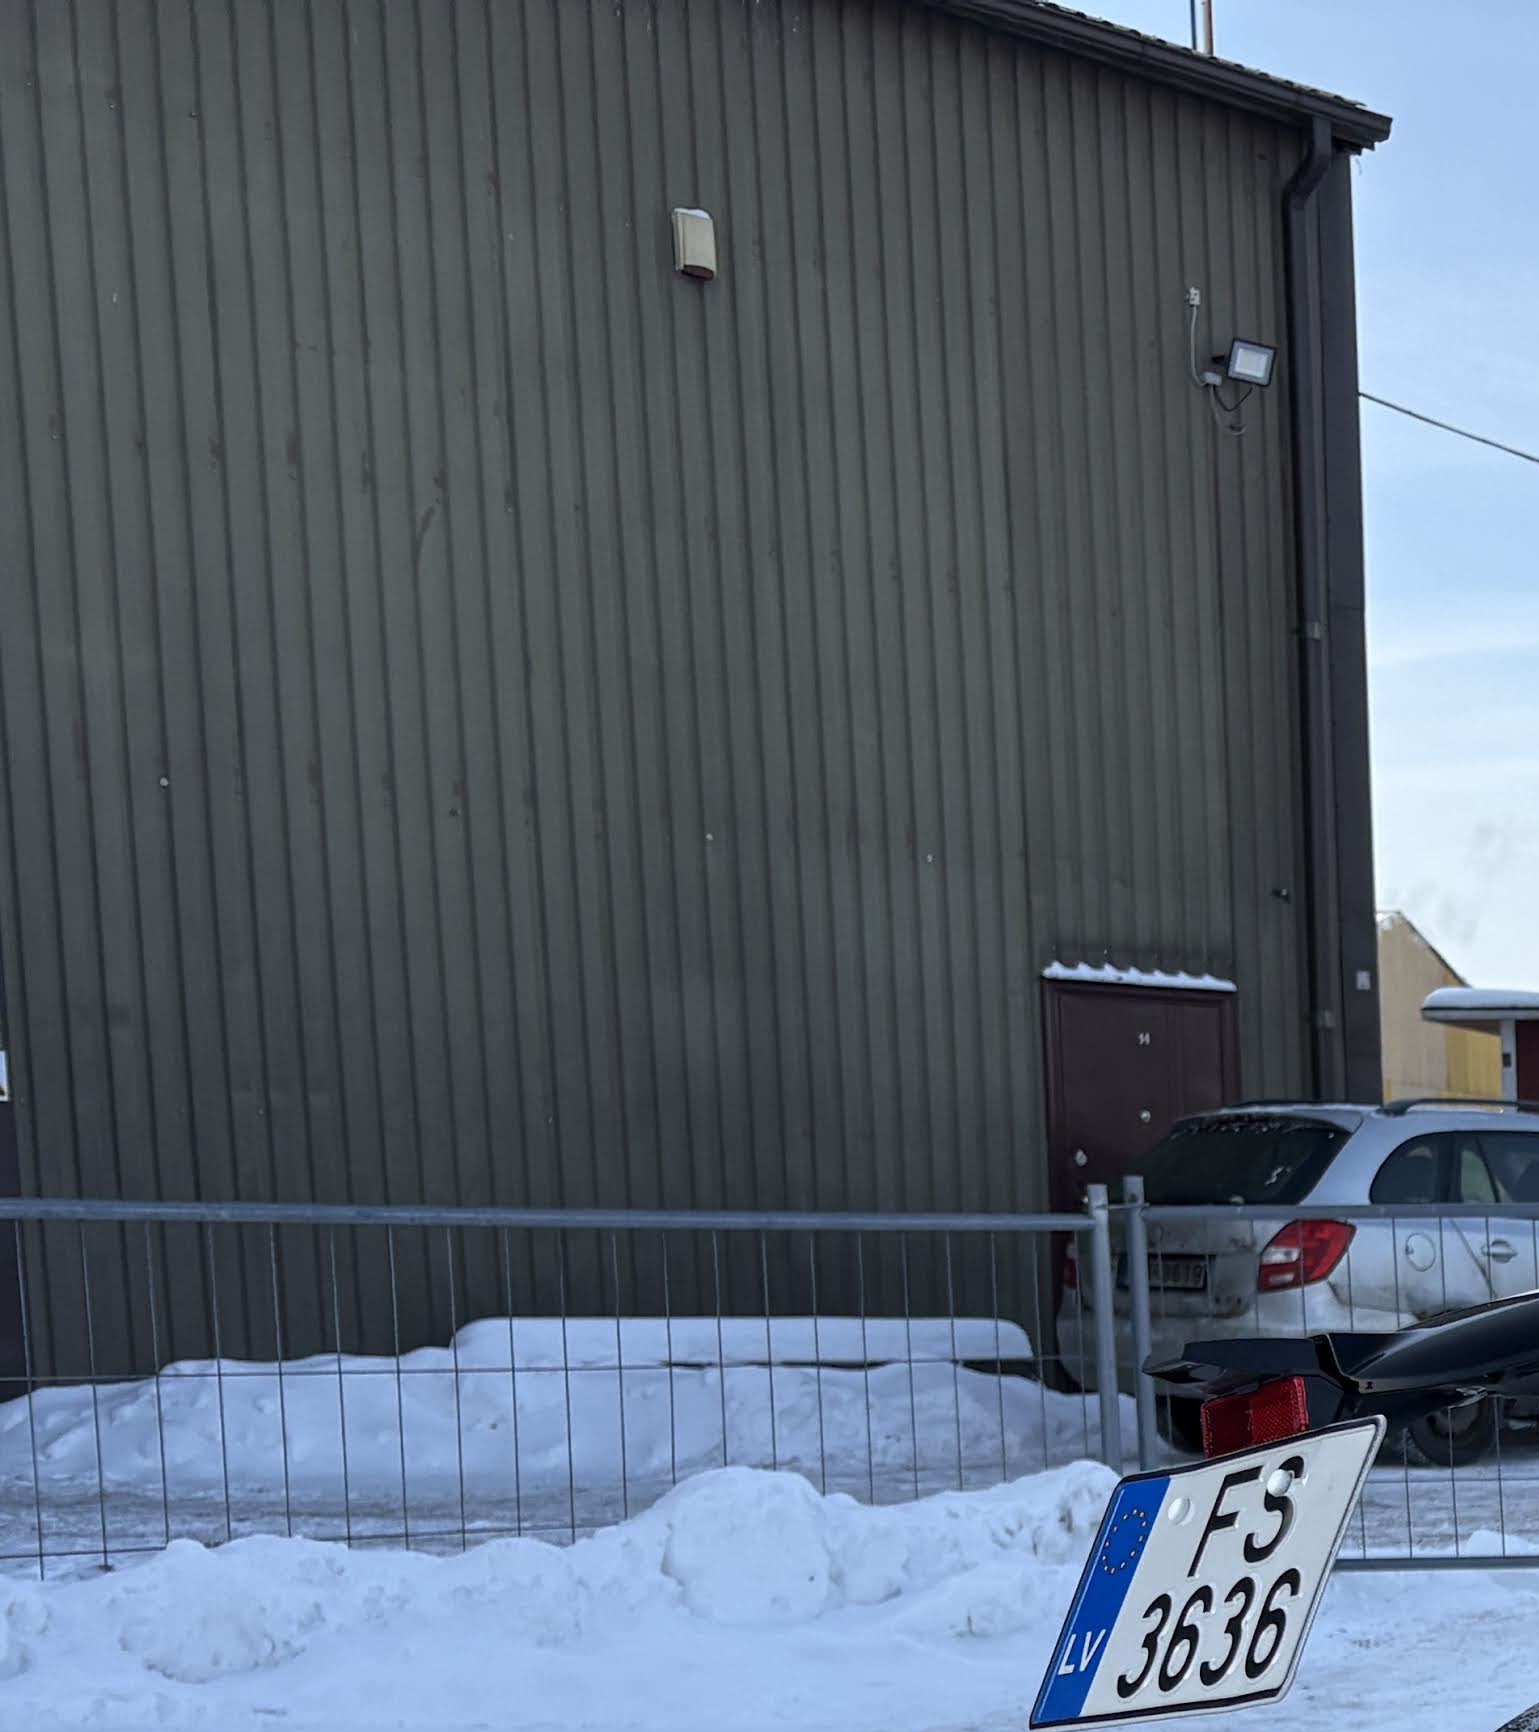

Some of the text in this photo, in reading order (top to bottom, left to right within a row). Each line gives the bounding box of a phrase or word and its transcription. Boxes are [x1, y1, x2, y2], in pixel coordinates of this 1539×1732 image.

[1187, 1455, 1305, 1578] FS
[1057, 1629, 1106, 1675] LV
[1116, 1567, 1301, 1699] 3636
